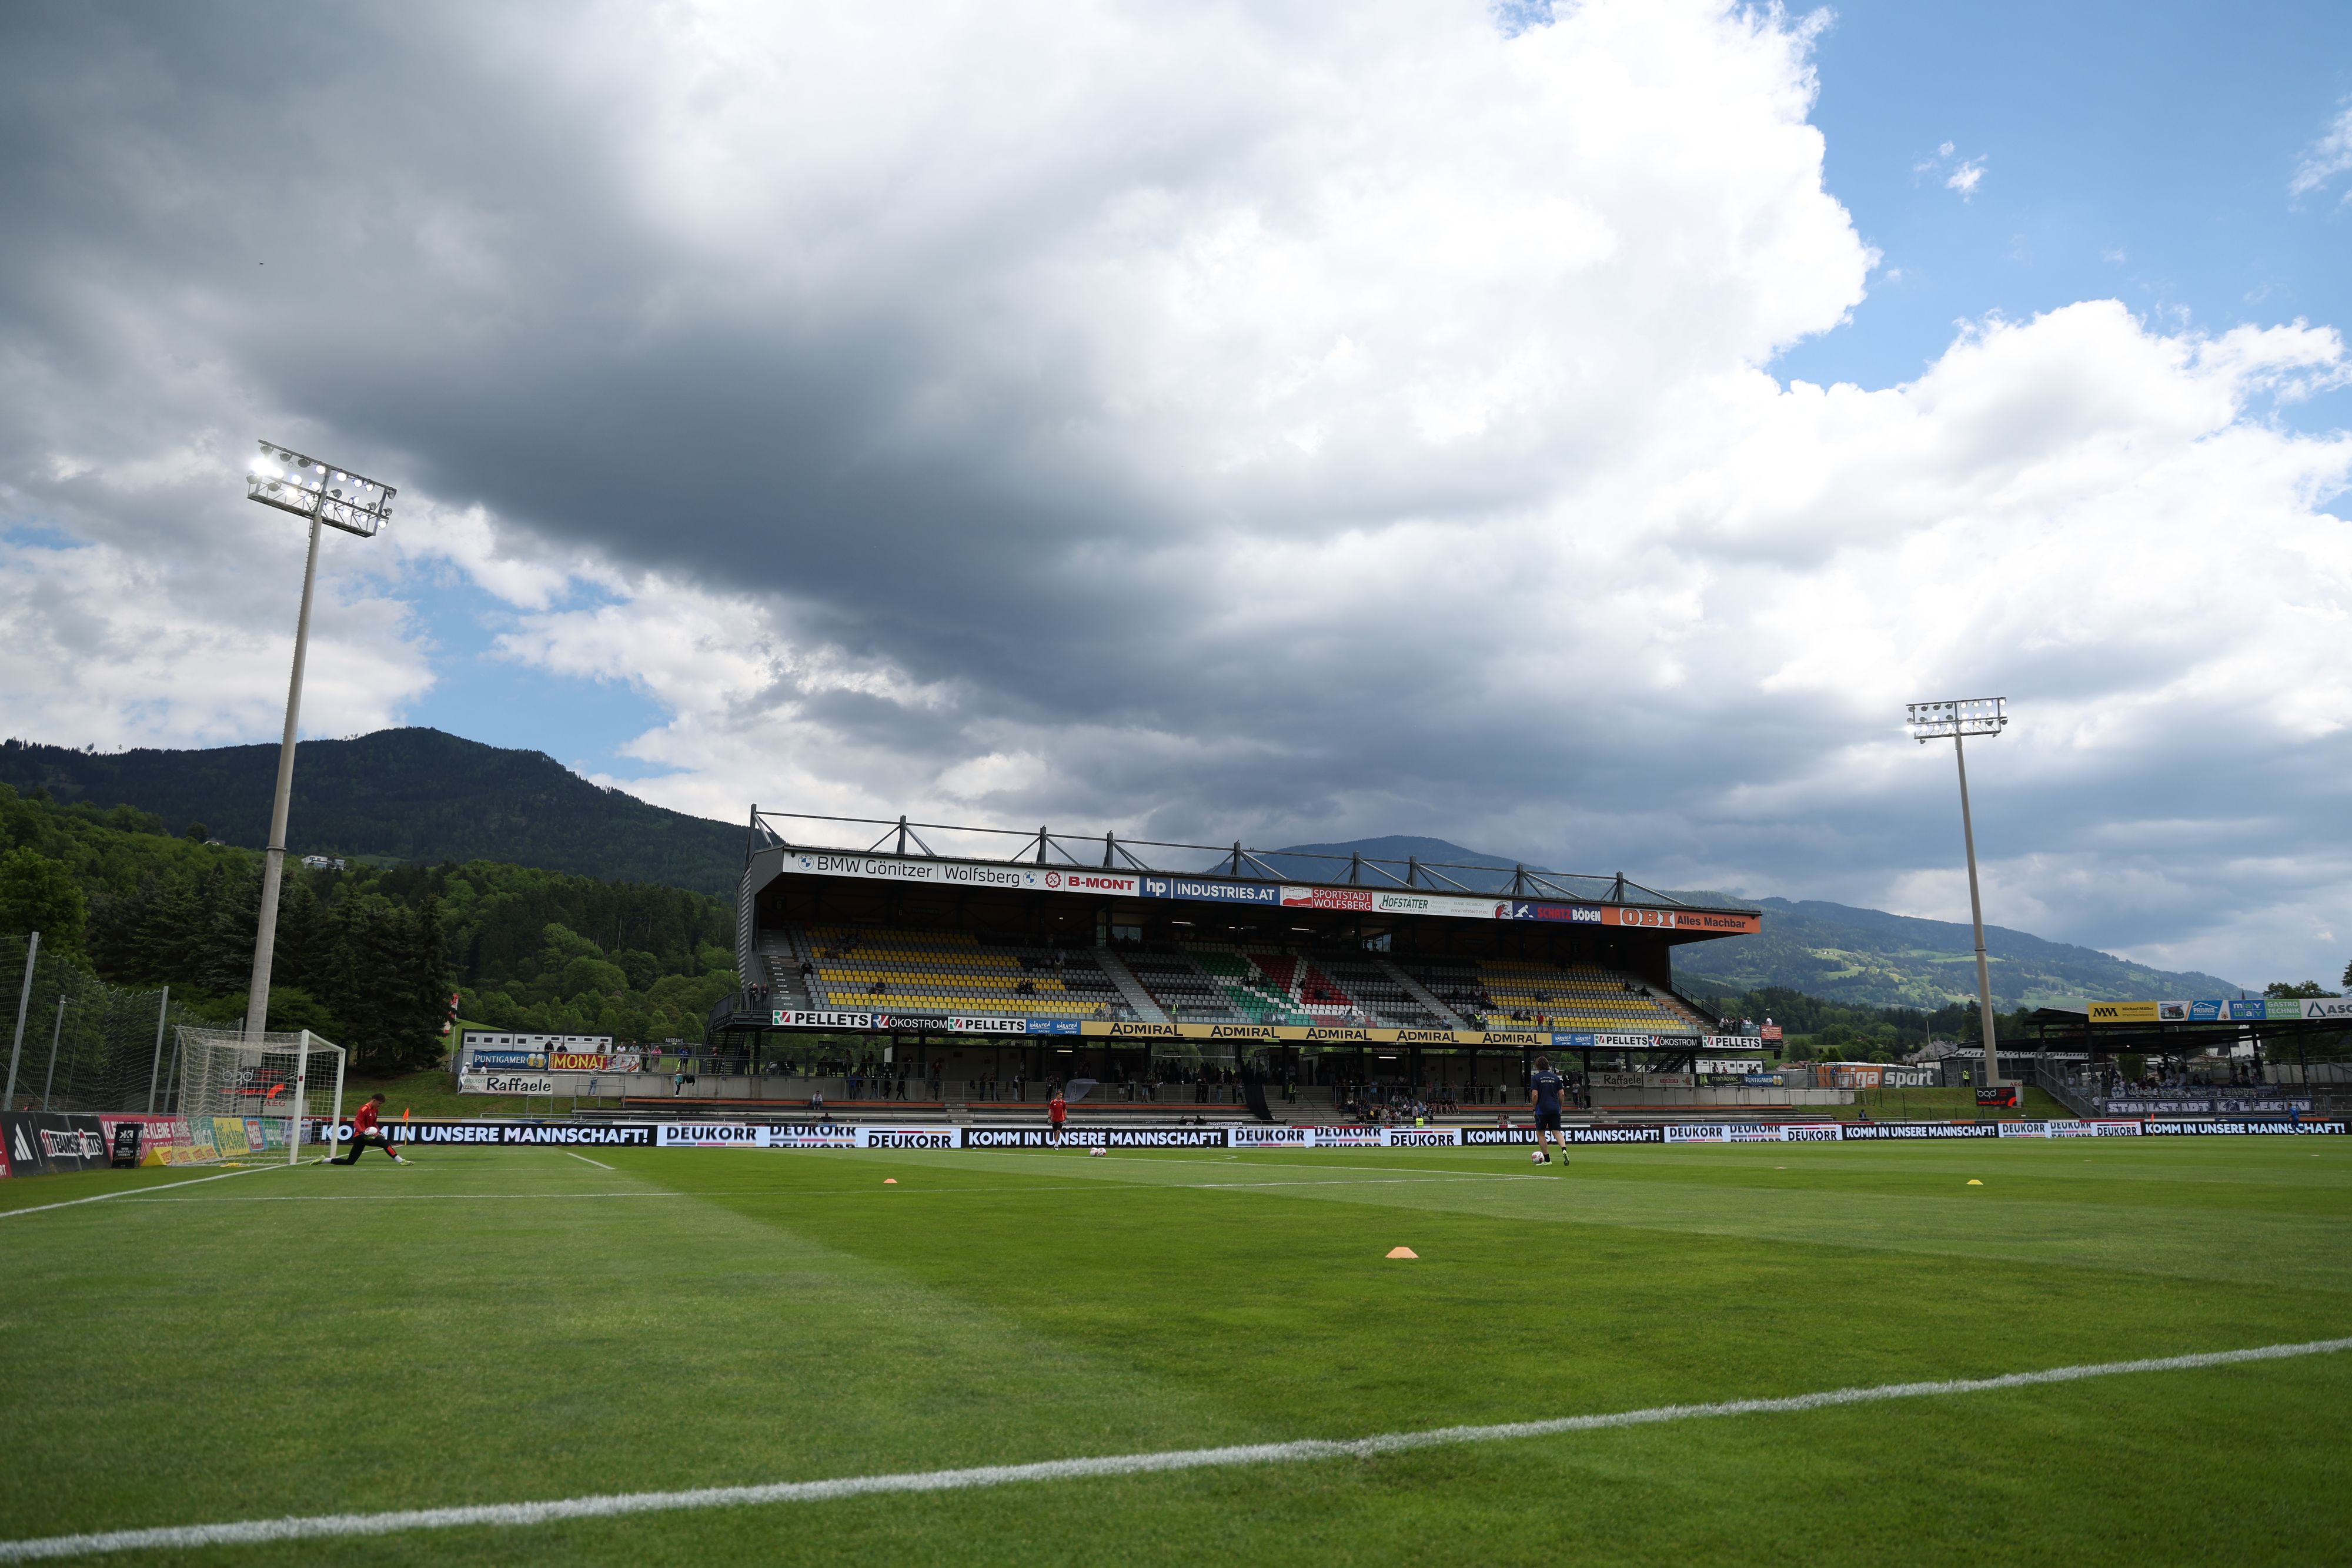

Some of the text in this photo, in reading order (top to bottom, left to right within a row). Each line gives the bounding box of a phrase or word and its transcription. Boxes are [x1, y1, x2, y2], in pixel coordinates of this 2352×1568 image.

[817, 856, 1020, 887] BMW Gönitzer Wolfsberg
[1068, 875, 1135, 890] B-MONT
[1146, 878, 1275, 900] hp INDUSTRIES.AT
[1314, 889, 1371, 901] SPORTSTADT
[1314, 898, 1371, 910] WOLFSBERG
[1537, 907, 1601, 922] SCHATZ BÖDEN
[1622, 908, 1673, 927] OBI
[1677, 915, 1746, 928] Alles Machbar
[795, 1012, 868, 1026] PELLETS
[889, 1016, 947, 1029] ÖKOSTROM
[965, 1019, 1025, 1031] PELLETS
[1110, 1022, 1184, 1037] ADMIRAL
[1210, 1025, 1281, 1039] ADMIRAL
[1306, 1027, 1373, 1041] ADMIRAL
[1396, 1029, 1459, 1043] ADMIRAL
[1482, 1032, 1542, 1045] ADMIRAL
[1606, 1036, 1648, 1045] PELLETS
[1660, 1037, 1698, 1047] ÖKOSTROM
[1716, 1038, 1760, 1048] PELLETS
[474, 1054, 526, 1064] PUNTIGAMER
[554, 1053, 607, 1070] MONAT
[1838, 1067, 1933, 1088] giga sport
[486, 1077, 552, 1092] Raffaele
[2108, 1102, 2209, 1112] STAHLSTADT
[149, 1121, 171, 1140] KLEINE
[321, 1125, 649, 1143] KO IN UNSERE MANNSCHAFT!
[666, 1127, 757, 1140] DEUKORR
[1235, 1129, 1305, 1141] DEUKORR
[1669, 1127, 1723, 1138] DEUKORR
[1846, 1126, 1995, 1138] KOMM IN UNSERE MANNSCHAFT!
[2003, 1124, 2045, 1133] DEUKORR
[2097, 1126, 2137, 1136] DEUKORR
[2145, 1123, 2346, 1134] KOMM IN UNSERE MANNSCHAFT!
[868, 1135, 952, 1148] DEUKORR
[968, 1132, 1221, 1145] KOMM IN UNSERE MANNSCHAFT!
[1391, 1135, 1455, 1146] DEUKORR
[1467, 1129, 1659, 1143] KOMM IN USEE MANNSCHAFT!
[1788, 1131, 1837, 1141] DEUKORR
